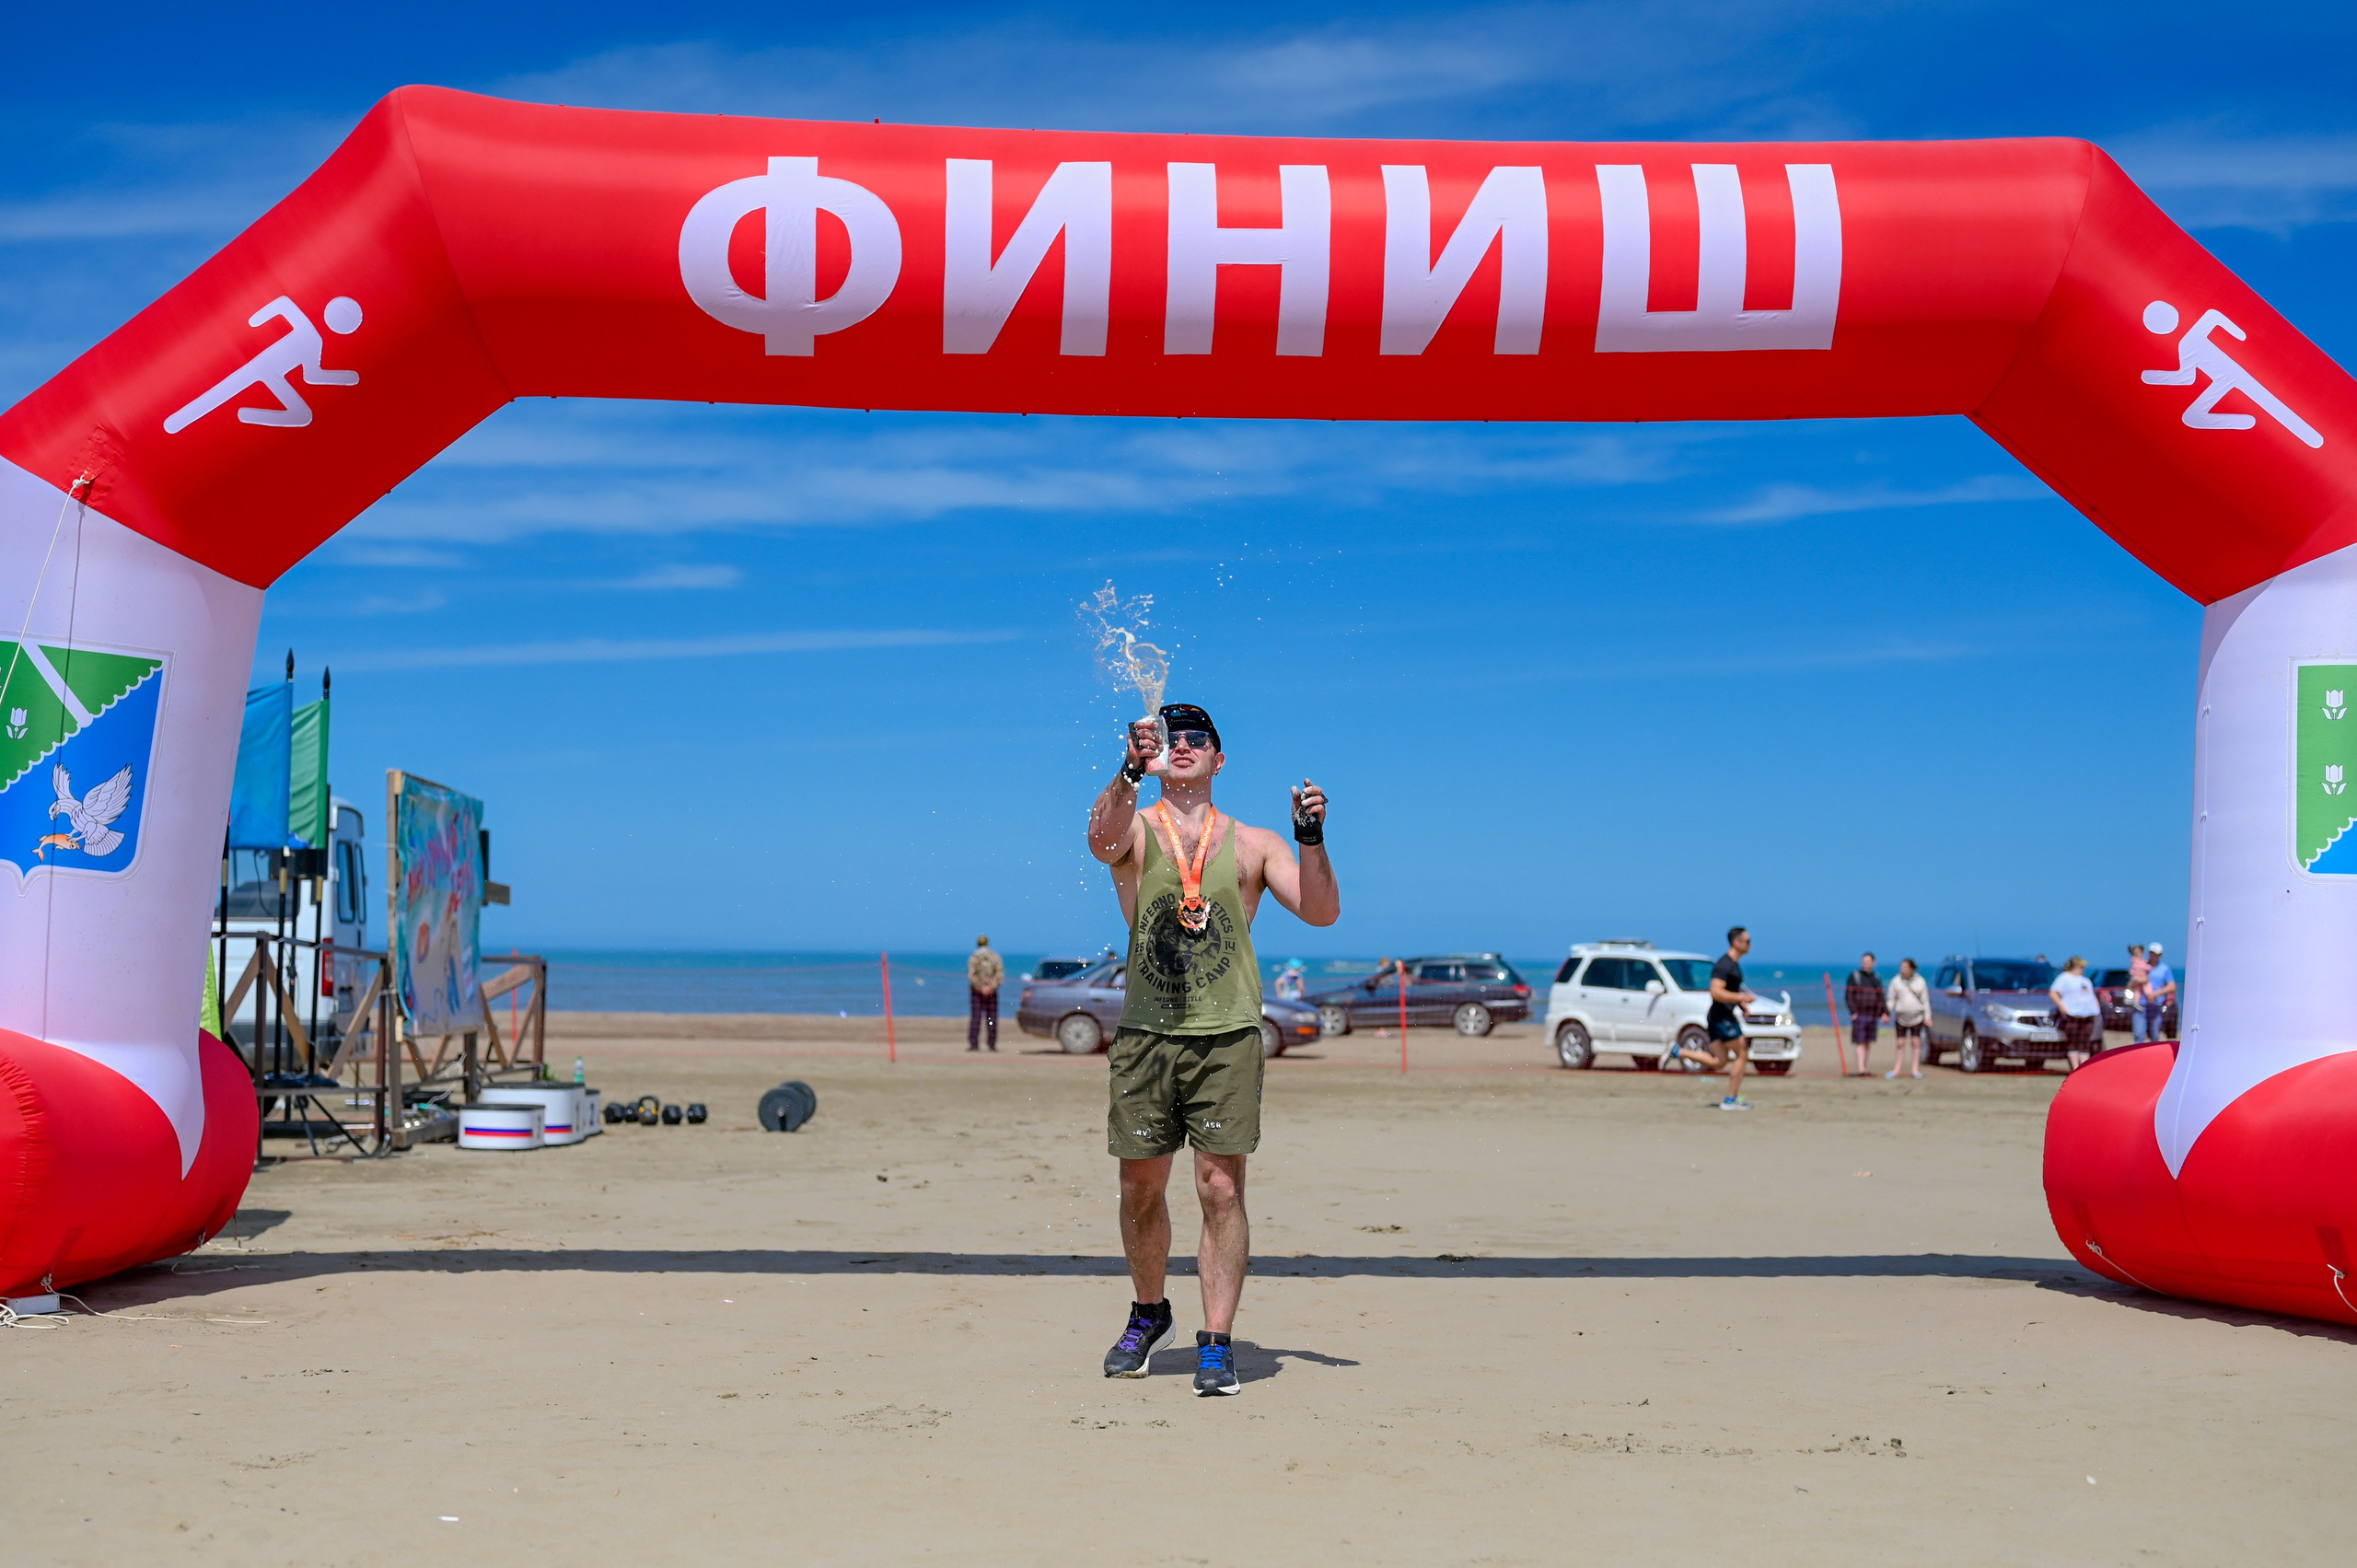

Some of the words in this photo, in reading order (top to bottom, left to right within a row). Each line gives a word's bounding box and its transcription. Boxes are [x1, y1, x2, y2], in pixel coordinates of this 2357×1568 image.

[679, 155, 1843, 356] ФИНИШ
[1138, 893, 1176, 935] INFERNO
[1180, 892, 1234, 935] ETICS
[1134, 941, 1144, 954] 25
[1225, 940, 1236, 952] 14
[1137, 958, 1191, 994] TRAINING
[1195, 956, 1231, 989] CAMP
